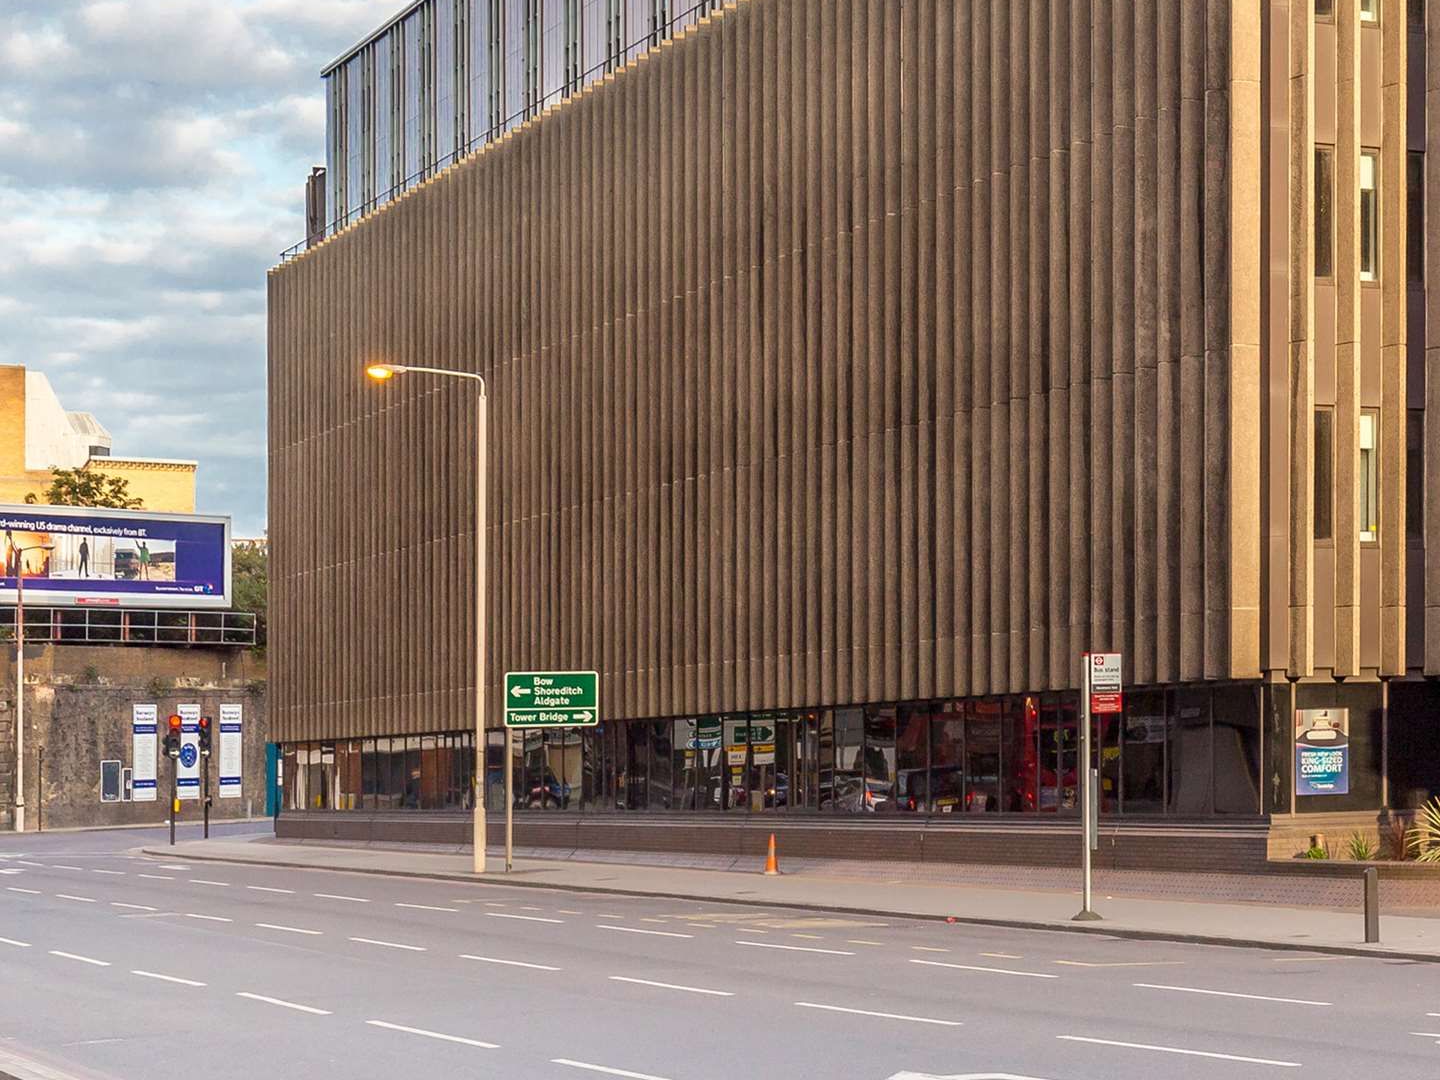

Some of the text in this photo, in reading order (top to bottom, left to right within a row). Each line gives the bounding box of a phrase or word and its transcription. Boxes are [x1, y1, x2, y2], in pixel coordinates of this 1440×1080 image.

[36, 521, 46, 530] US
[47, 521, 68, 532] drama
[124, 527, 138, 536] from
[533, 676, 554, 686] Bow
[534, 686, 583, 696] Shoreditch
[534, 696, 570, 707] Aldgate
[510, 712, 569, 723] Tower Bridge
[1301, 764, 1343, 773] COMFORT
